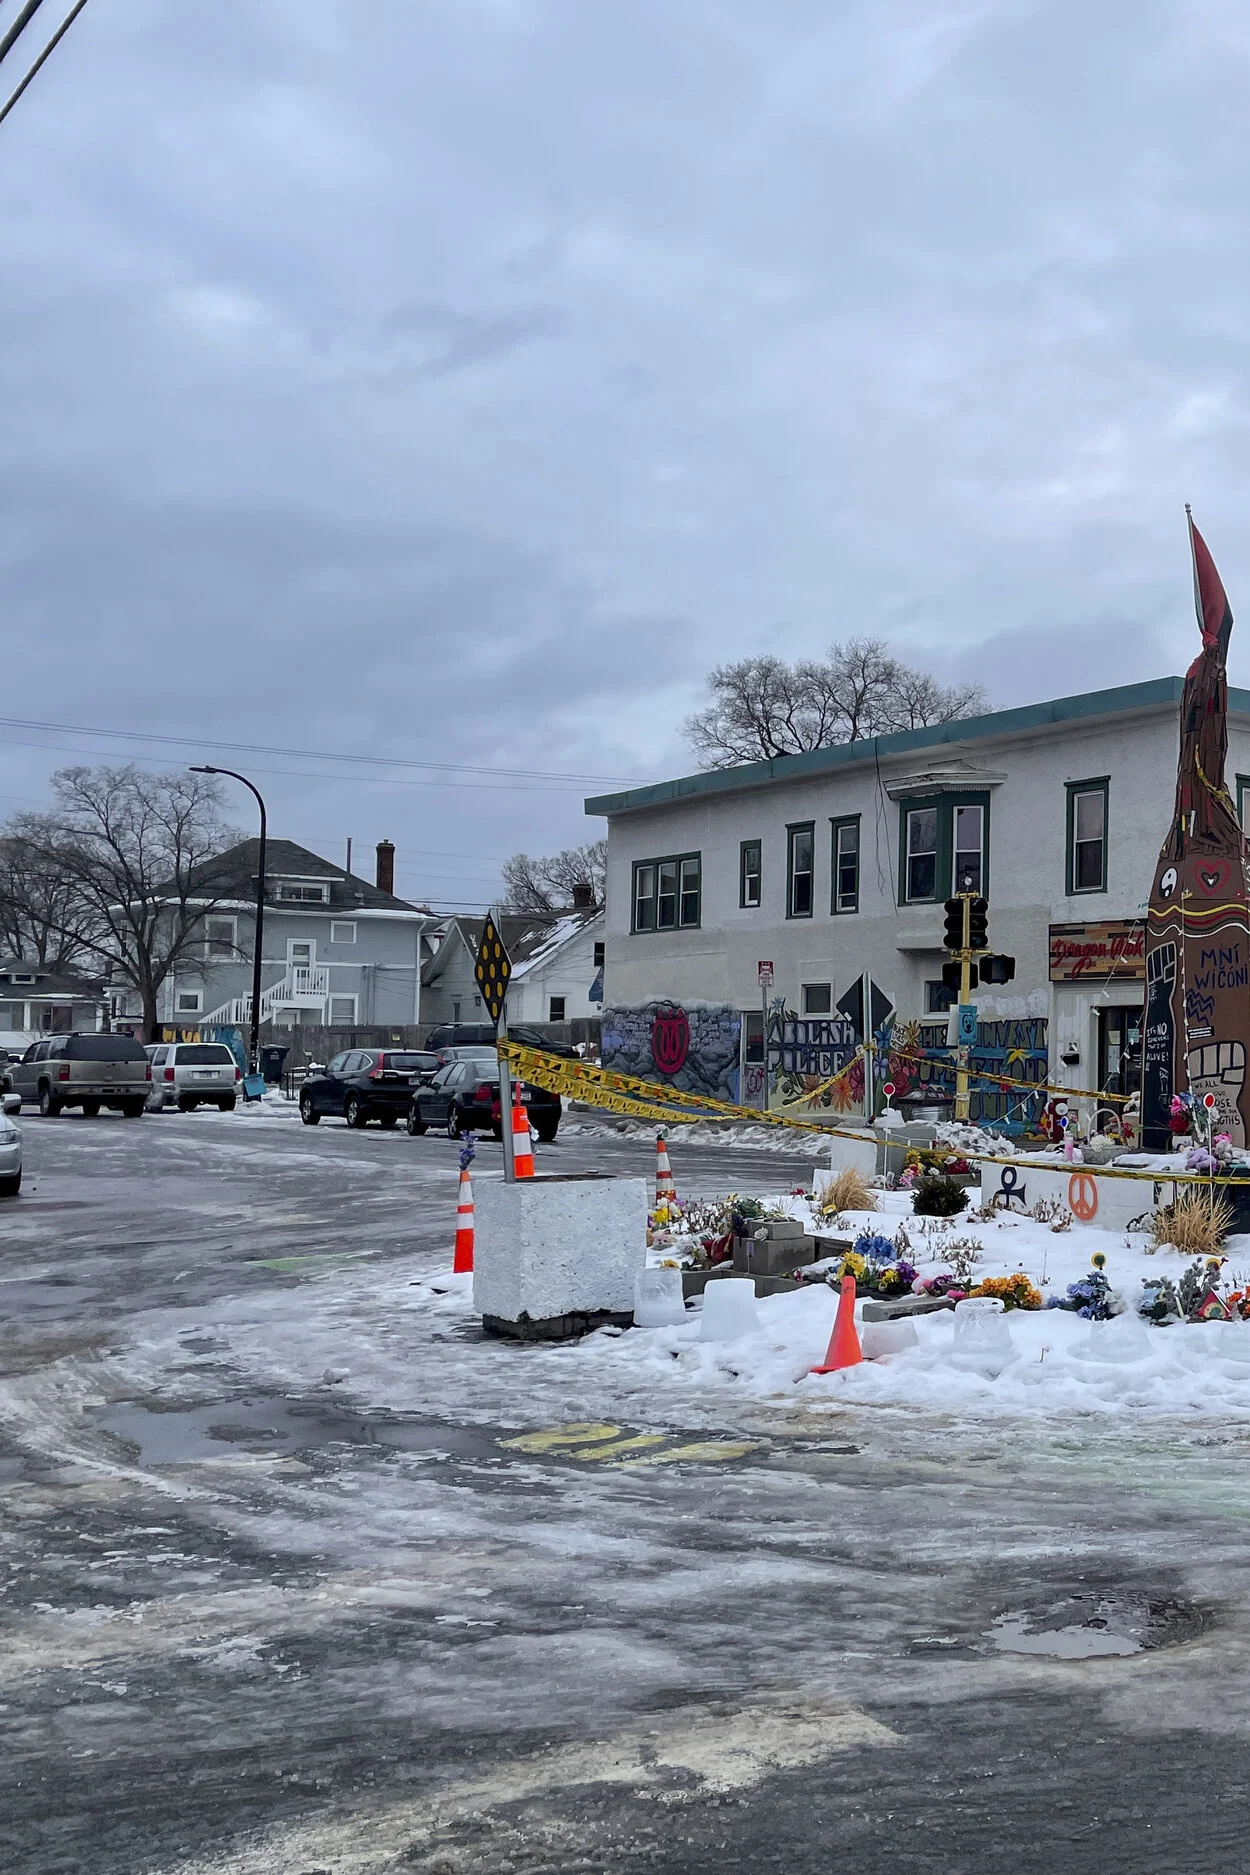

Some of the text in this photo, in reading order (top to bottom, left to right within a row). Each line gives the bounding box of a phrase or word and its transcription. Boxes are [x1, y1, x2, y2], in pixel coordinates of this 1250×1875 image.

[1050, 930, 1145, 980] Dragon Wok
[1157, 1022, 1167, 1036] NO
[1146, 1052, 1169, 1062] ALIVE!
